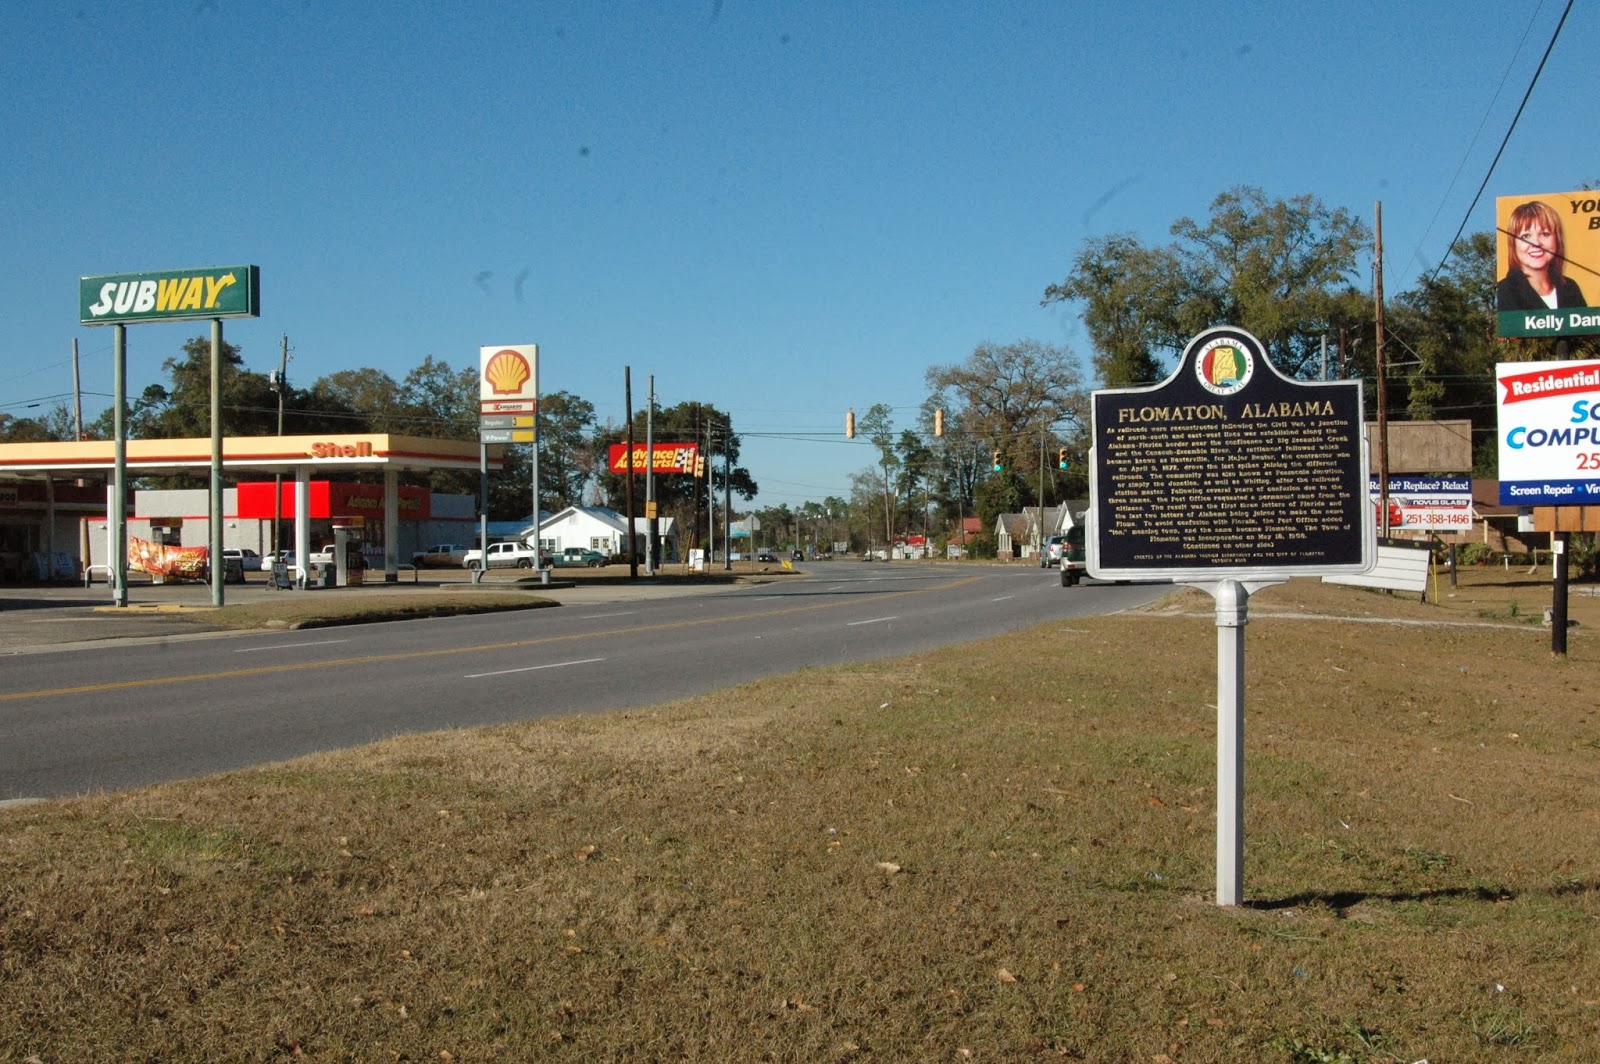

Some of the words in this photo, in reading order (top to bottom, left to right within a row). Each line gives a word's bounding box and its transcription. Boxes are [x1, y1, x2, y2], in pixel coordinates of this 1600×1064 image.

[1570, 200, 1600, 214] YO
[90, 272, 236, 316] SUBWAY
[1525, 316, 1564, 330] Kelly
[1204, 339, 1242, 352] ALABAMA
[1204, 381, 1224, 394] GREAT
[1229, 381, 1246, 393] SEAL
[1512, 370, 1600, 396] Residential
[1119, 405, 1227, 423] FLOMATON,
[1241, 401, 1334, 418] ALABAMA
[312, 442, 372, 458] Shell
[620, 448, 674, 460] Advnce
[1370, 481, 1402, 490] Reir?
[1403, 481, 1440, 491] Replace?
[1442, 481, 1468, 490] Relax!
[1510, 485, 1542, 496] Screen
[1543, 484, 1574, 497] Repair
[1406, 514, 1469, 524] 251-368-1466
